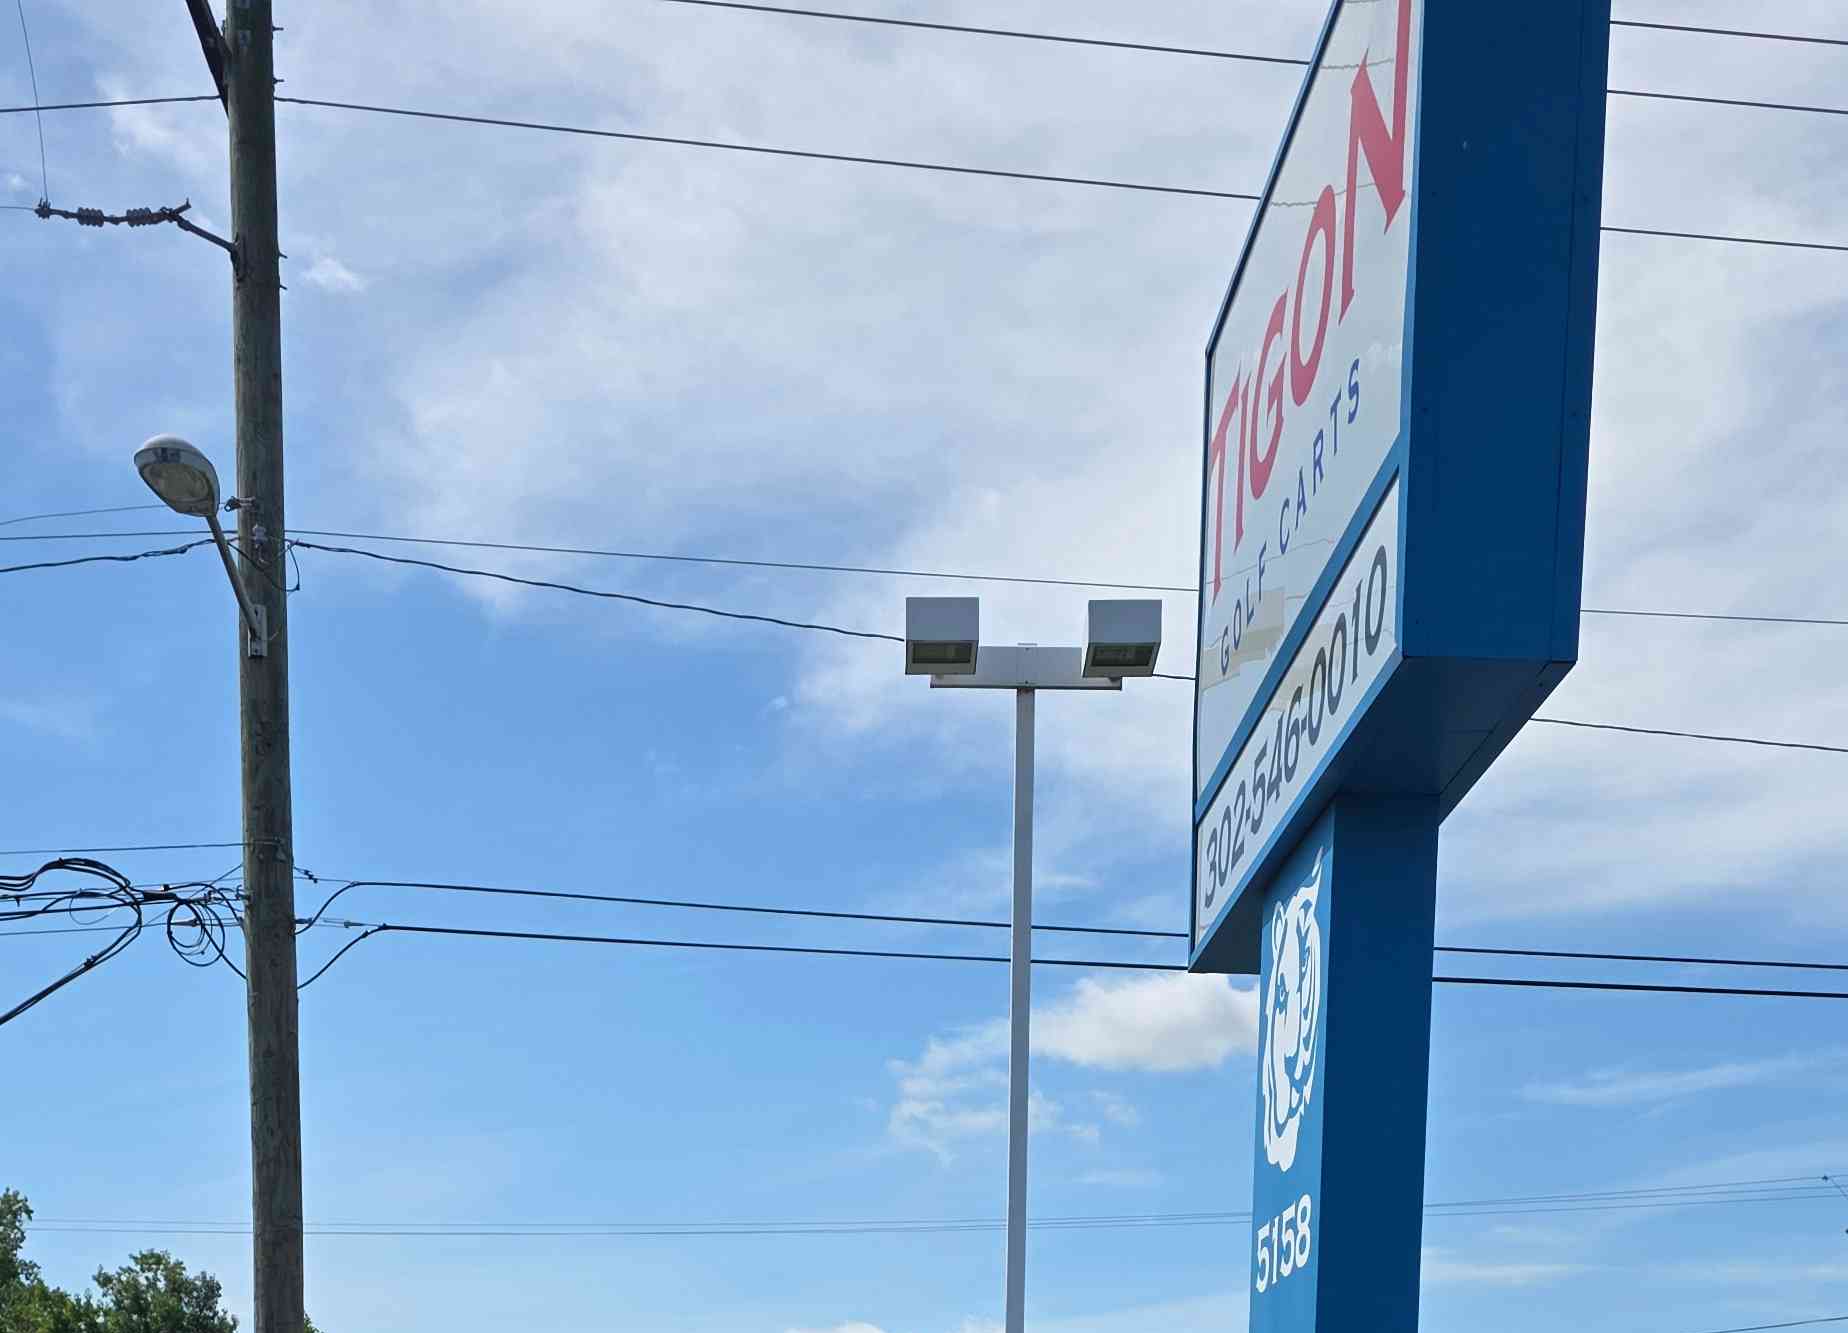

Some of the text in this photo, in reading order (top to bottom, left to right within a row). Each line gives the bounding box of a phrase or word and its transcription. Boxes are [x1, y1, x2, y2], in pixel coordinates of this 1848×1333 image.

[1210, 0, 1411, 606] TIGON
[1220, 358, 1359, 676] GOLF CARTS
[1204, 545, 1387, 908] 302-546-0010
[1256, 1194, 1312, 1293] 5158
